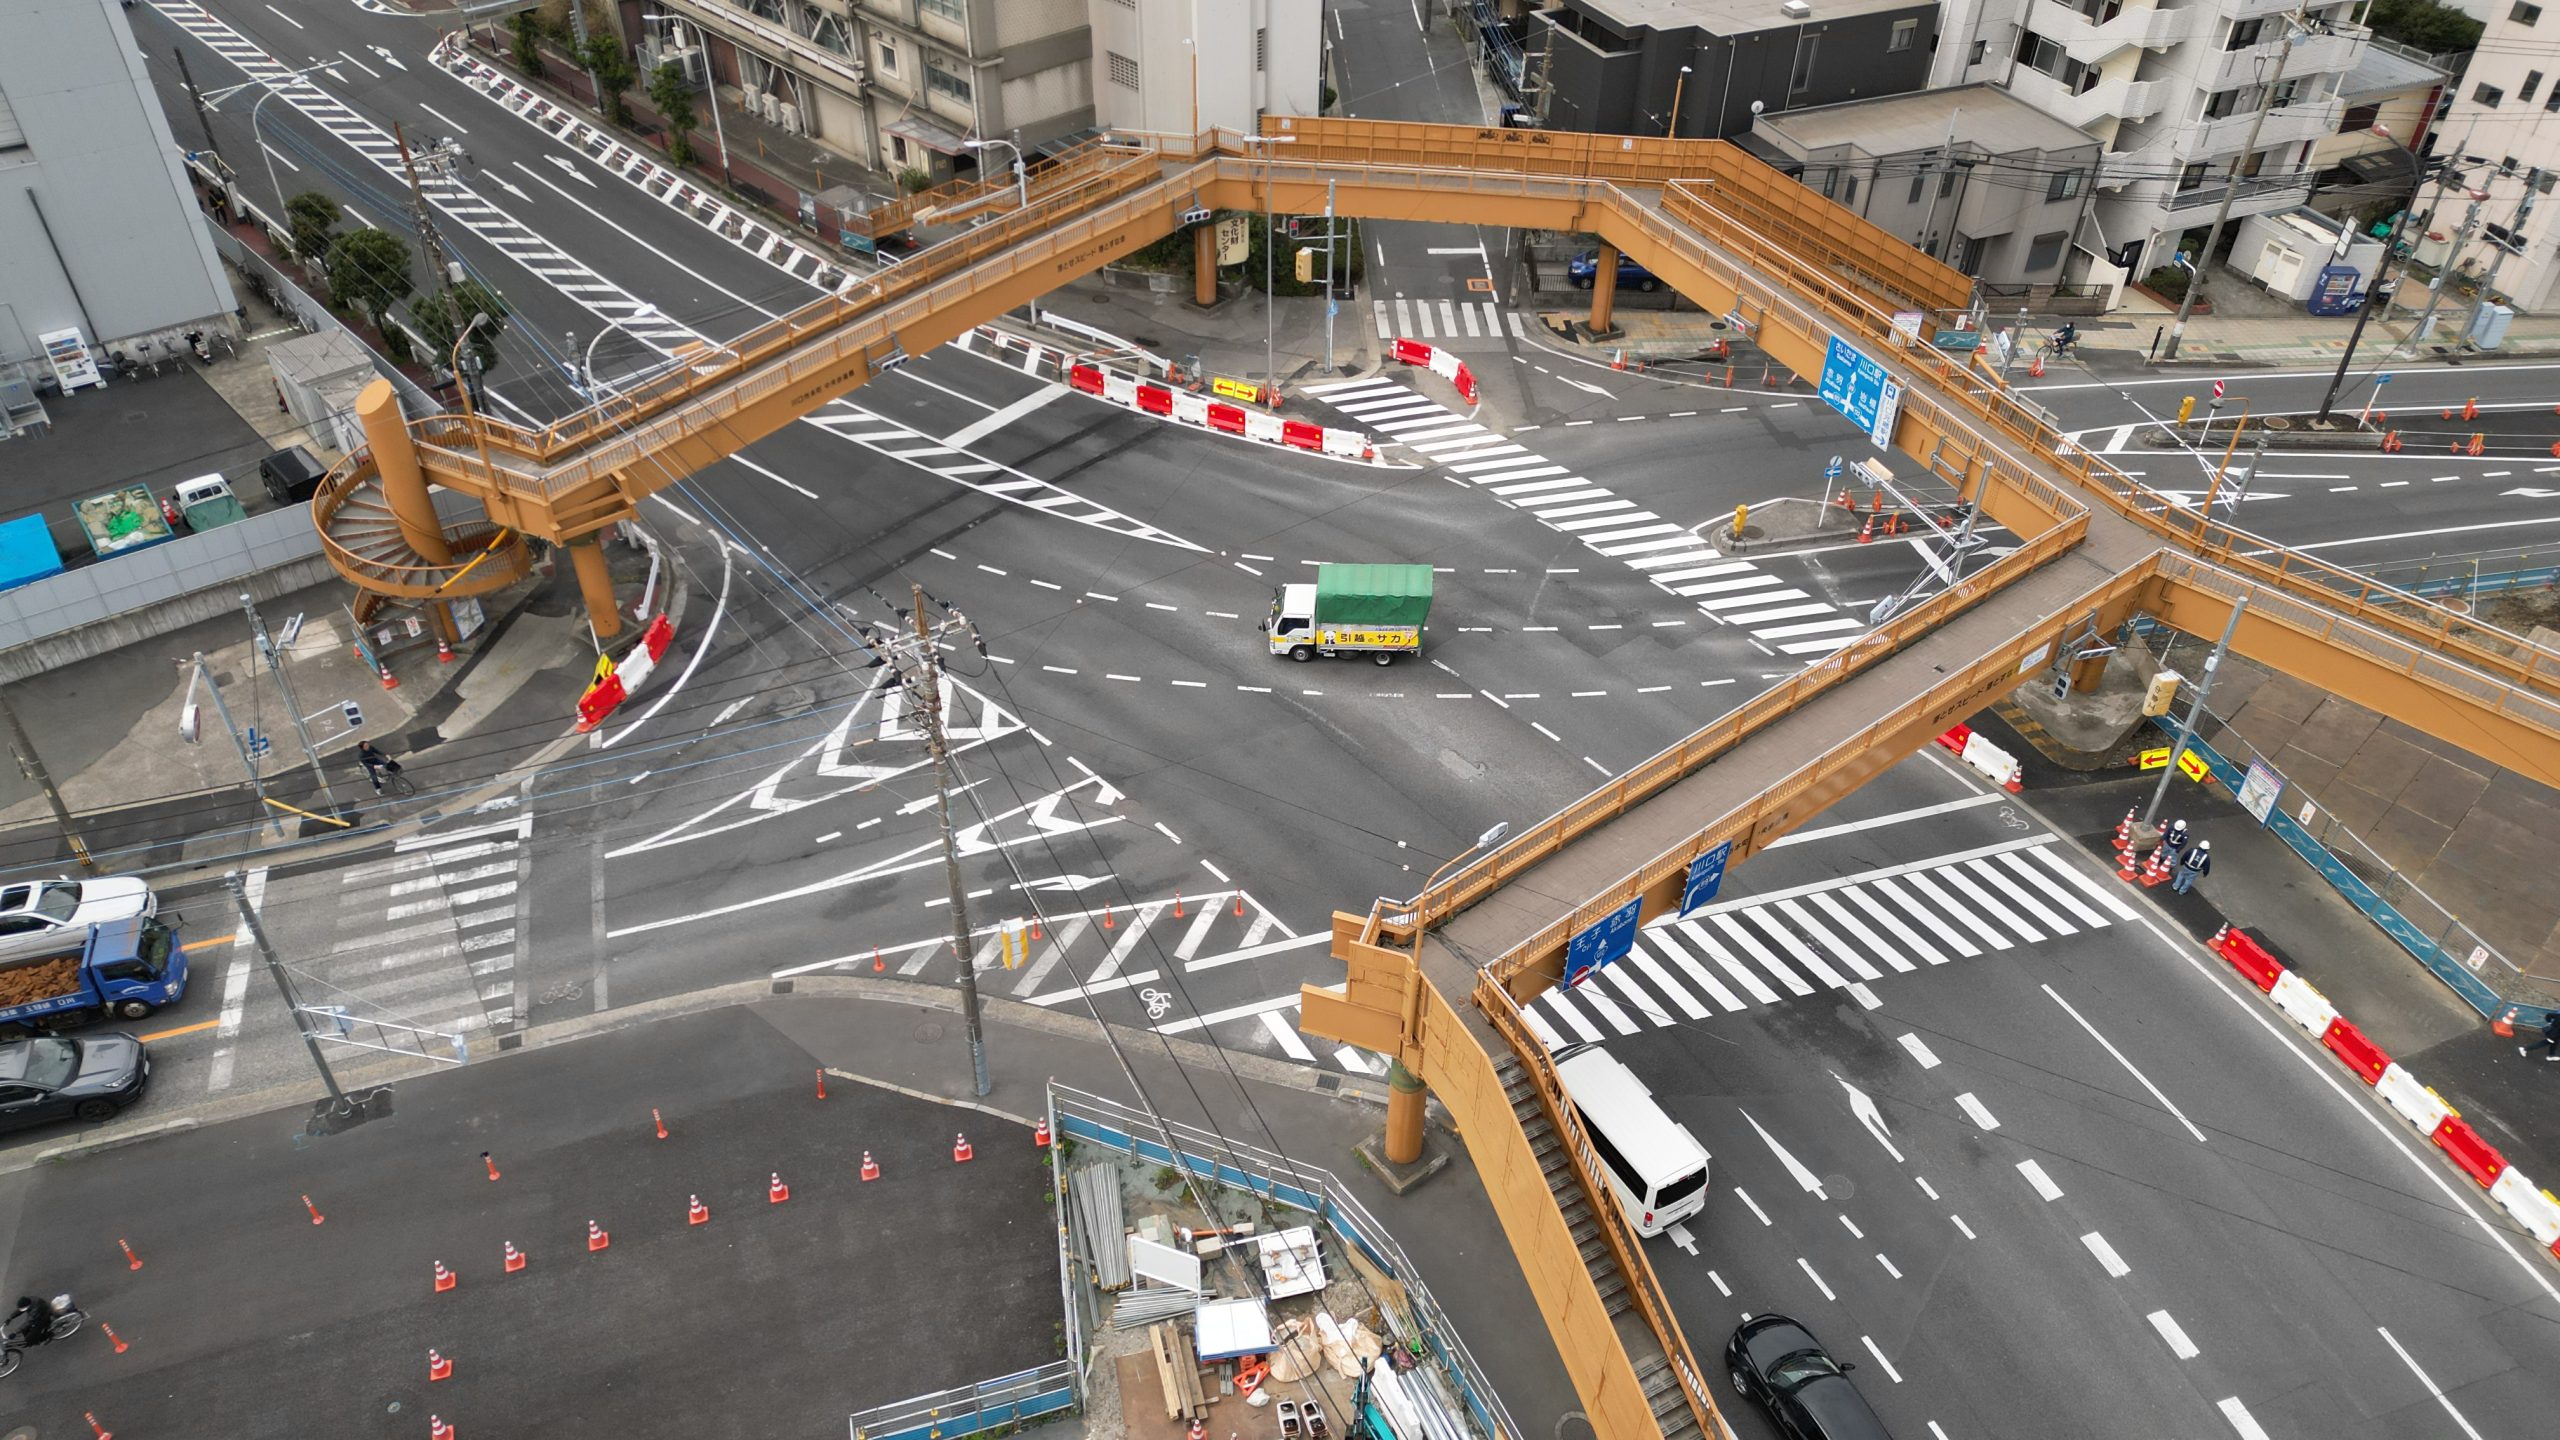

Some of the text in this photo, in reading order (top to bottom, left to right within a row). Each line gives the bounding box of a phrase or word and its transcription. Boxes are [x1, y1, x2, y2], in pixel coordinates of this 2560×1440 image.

[1694, 846, 1728, 875] 川口駅
[1575, 926, 1602, 951] 王子
